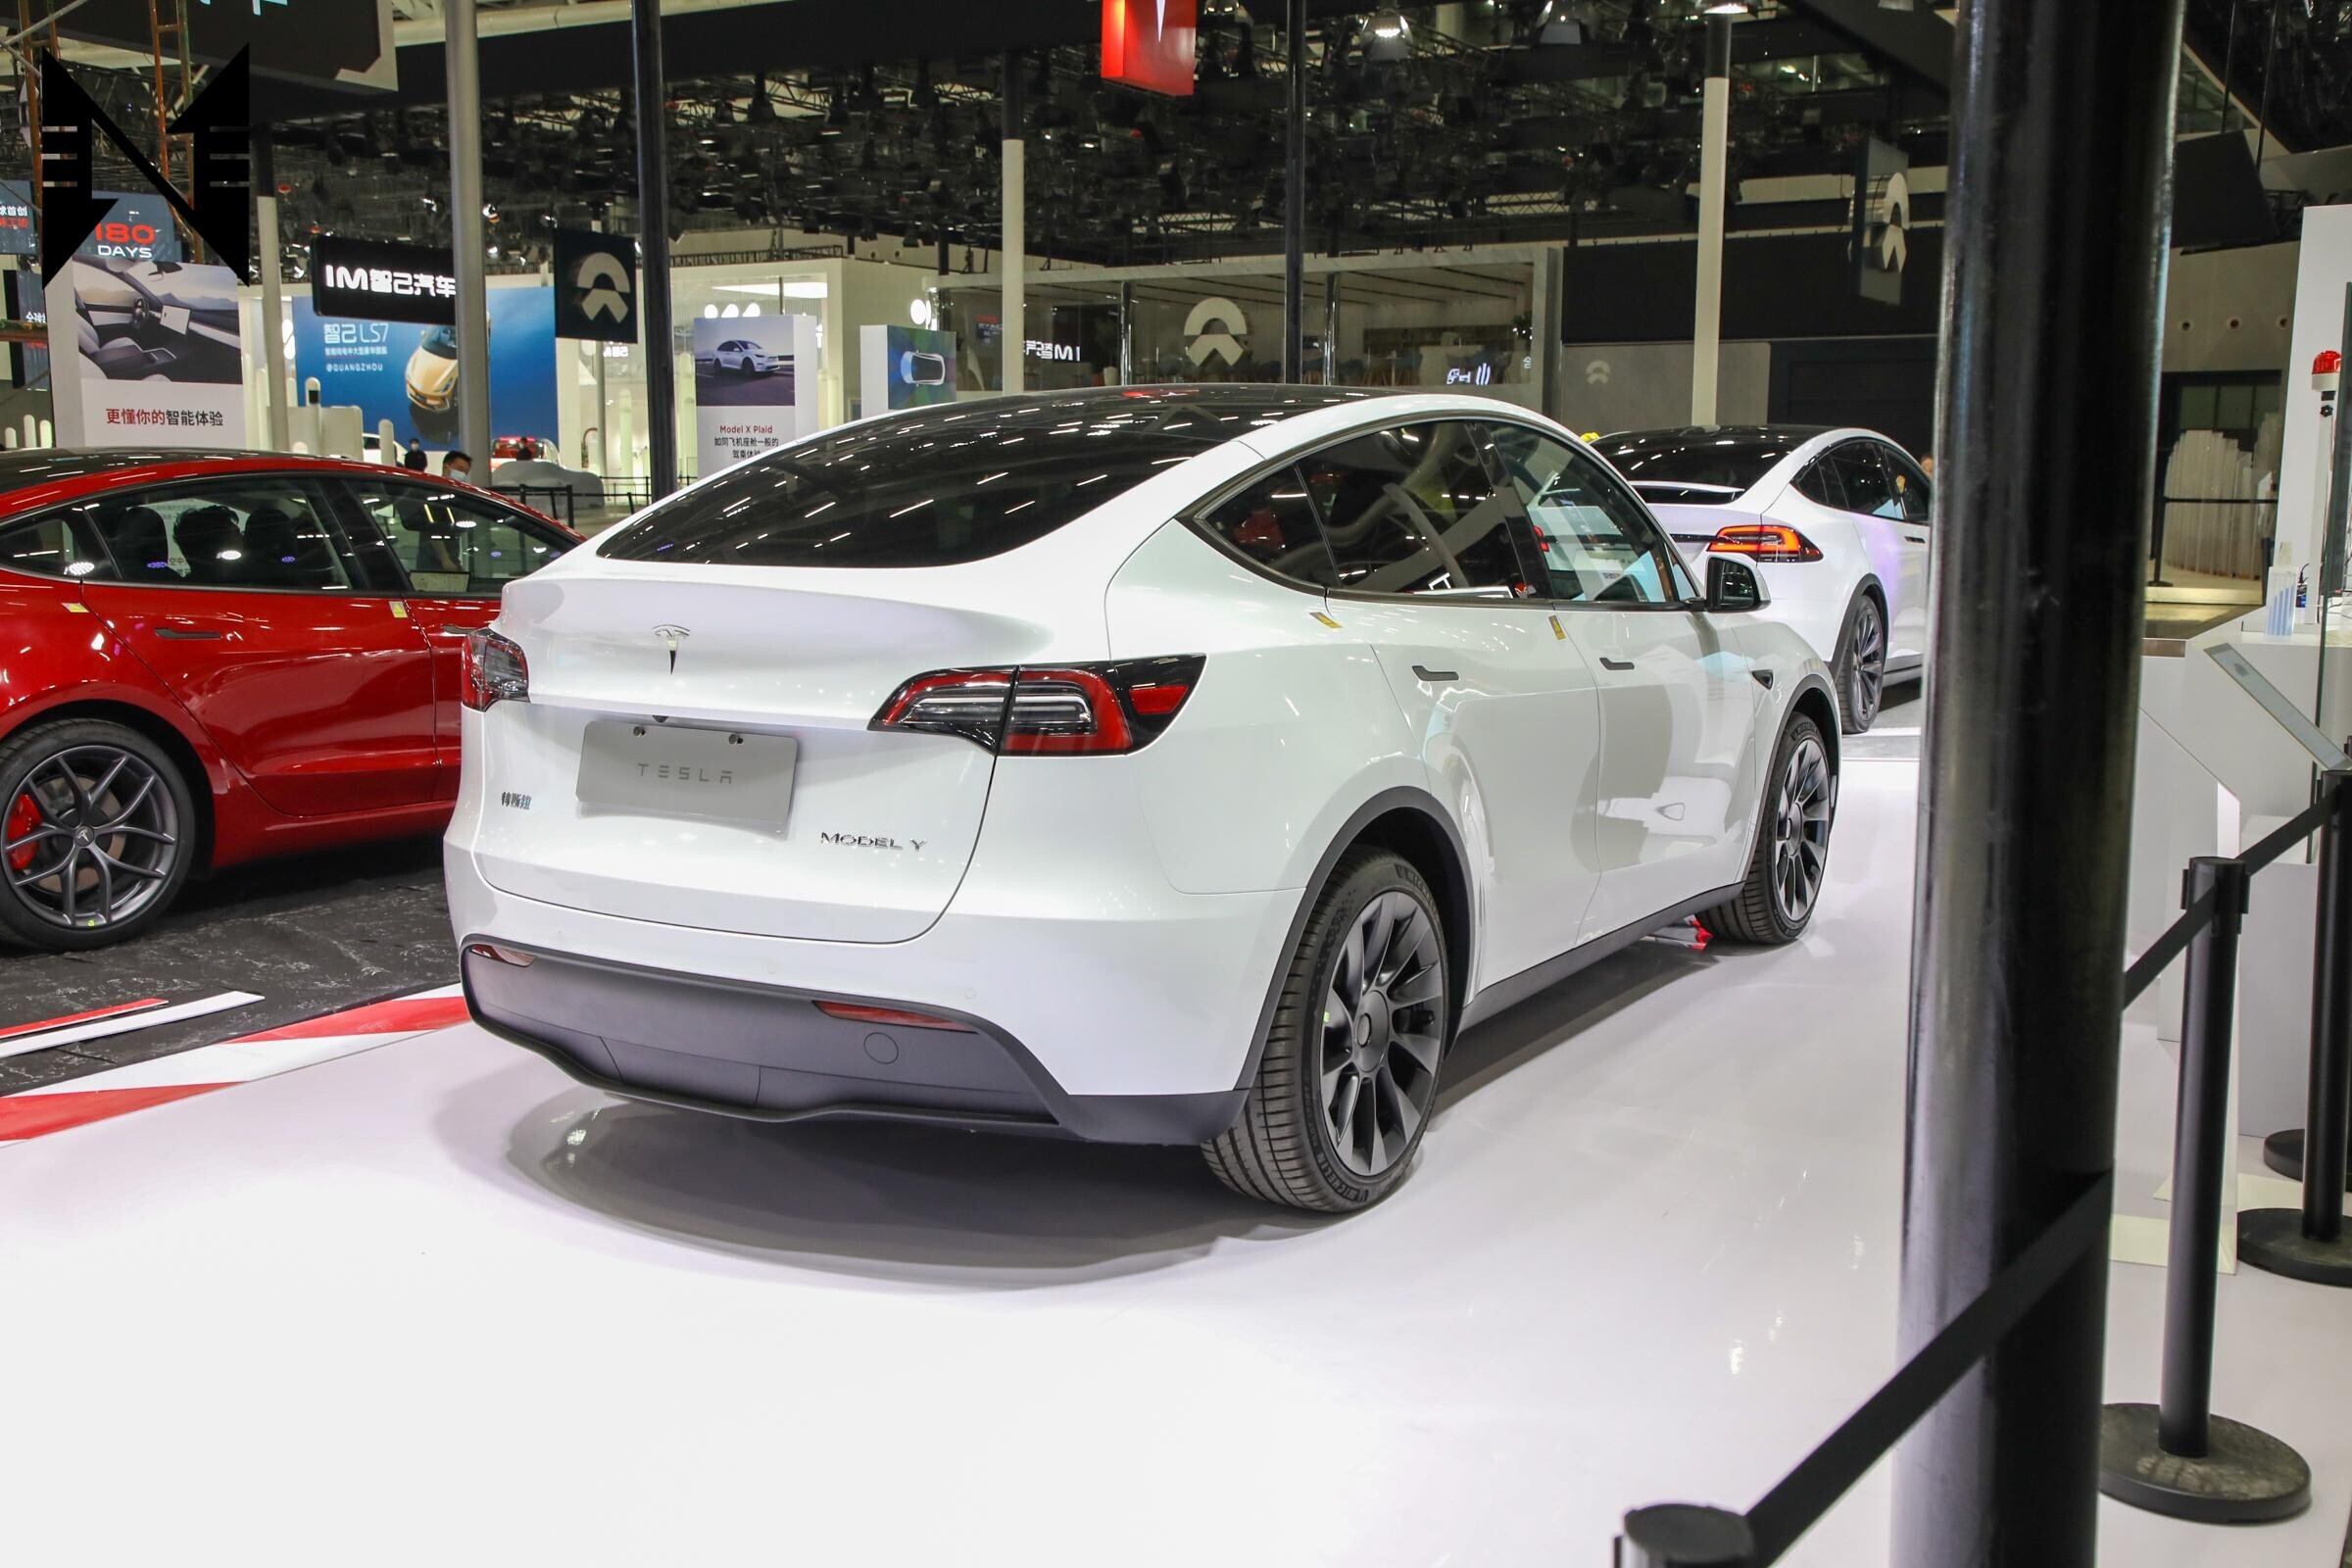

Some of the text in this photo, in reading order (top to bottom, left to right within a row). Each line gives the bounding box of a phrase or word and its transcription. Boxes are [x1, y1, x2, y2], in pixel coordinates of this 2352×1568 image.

[94, 222, 157, 245] 180
[97, 245, 153, 259] DAYS
[325, 362, 384, 373] @GUANGZHOU
[105, 408, 224, 427] 更懂你的智能体验
[719, 424, 773, 434] Model X Plaid
[637, 762, 733, 785] TESLA
[820, 831, 927, 853] MODEL Y
